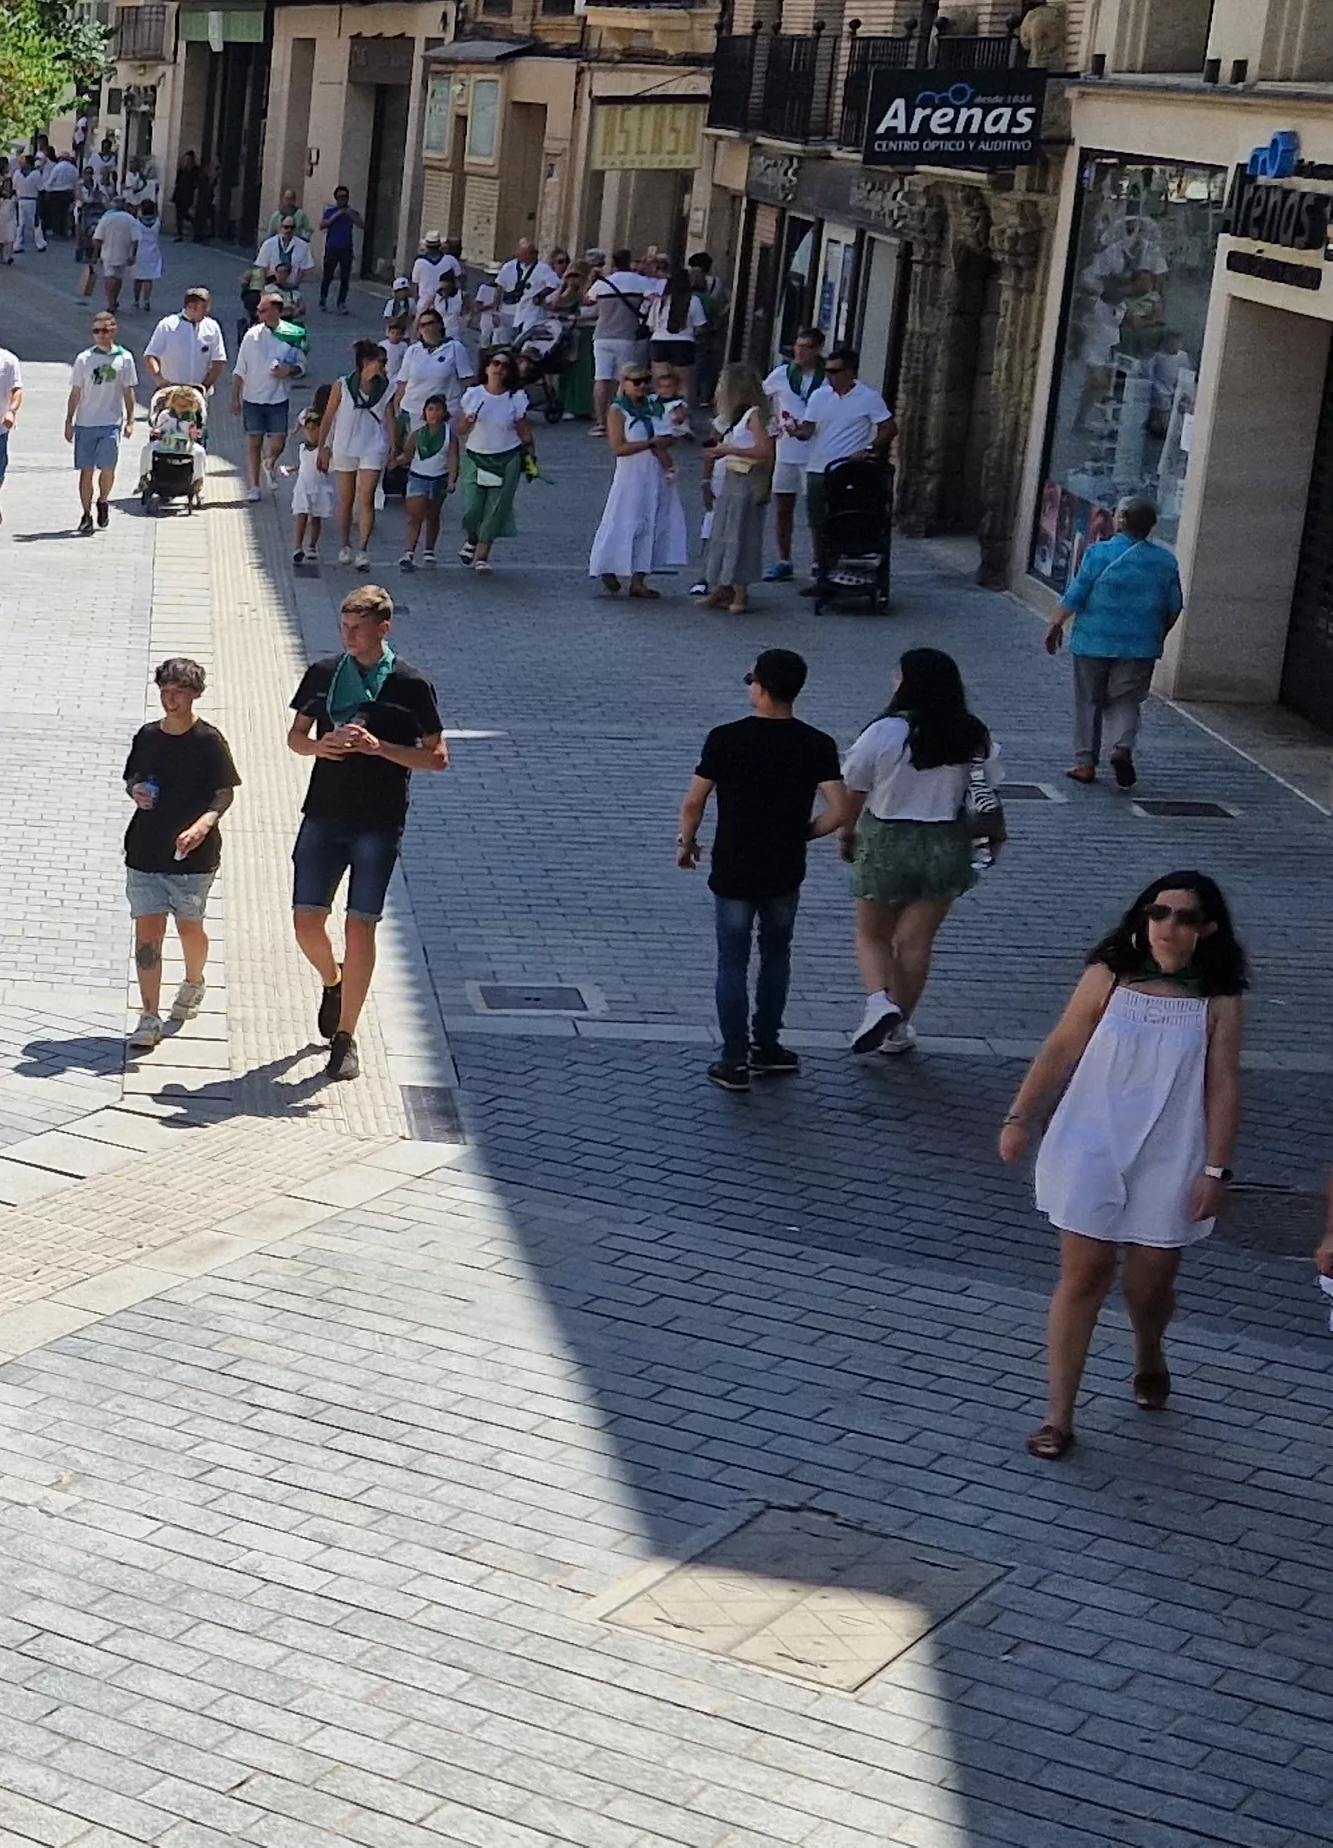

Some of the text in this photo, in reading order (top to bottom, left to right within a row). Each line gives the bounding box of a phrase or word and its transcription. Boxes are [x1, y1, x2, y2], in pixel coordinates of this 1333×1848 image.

[874, 97, 1036, 134] Arenas
[874, 140, 919, 151] CENTRO
[967, 140, 976, 151] Y
[978, 140, 1032, 151] AUDITIVO
